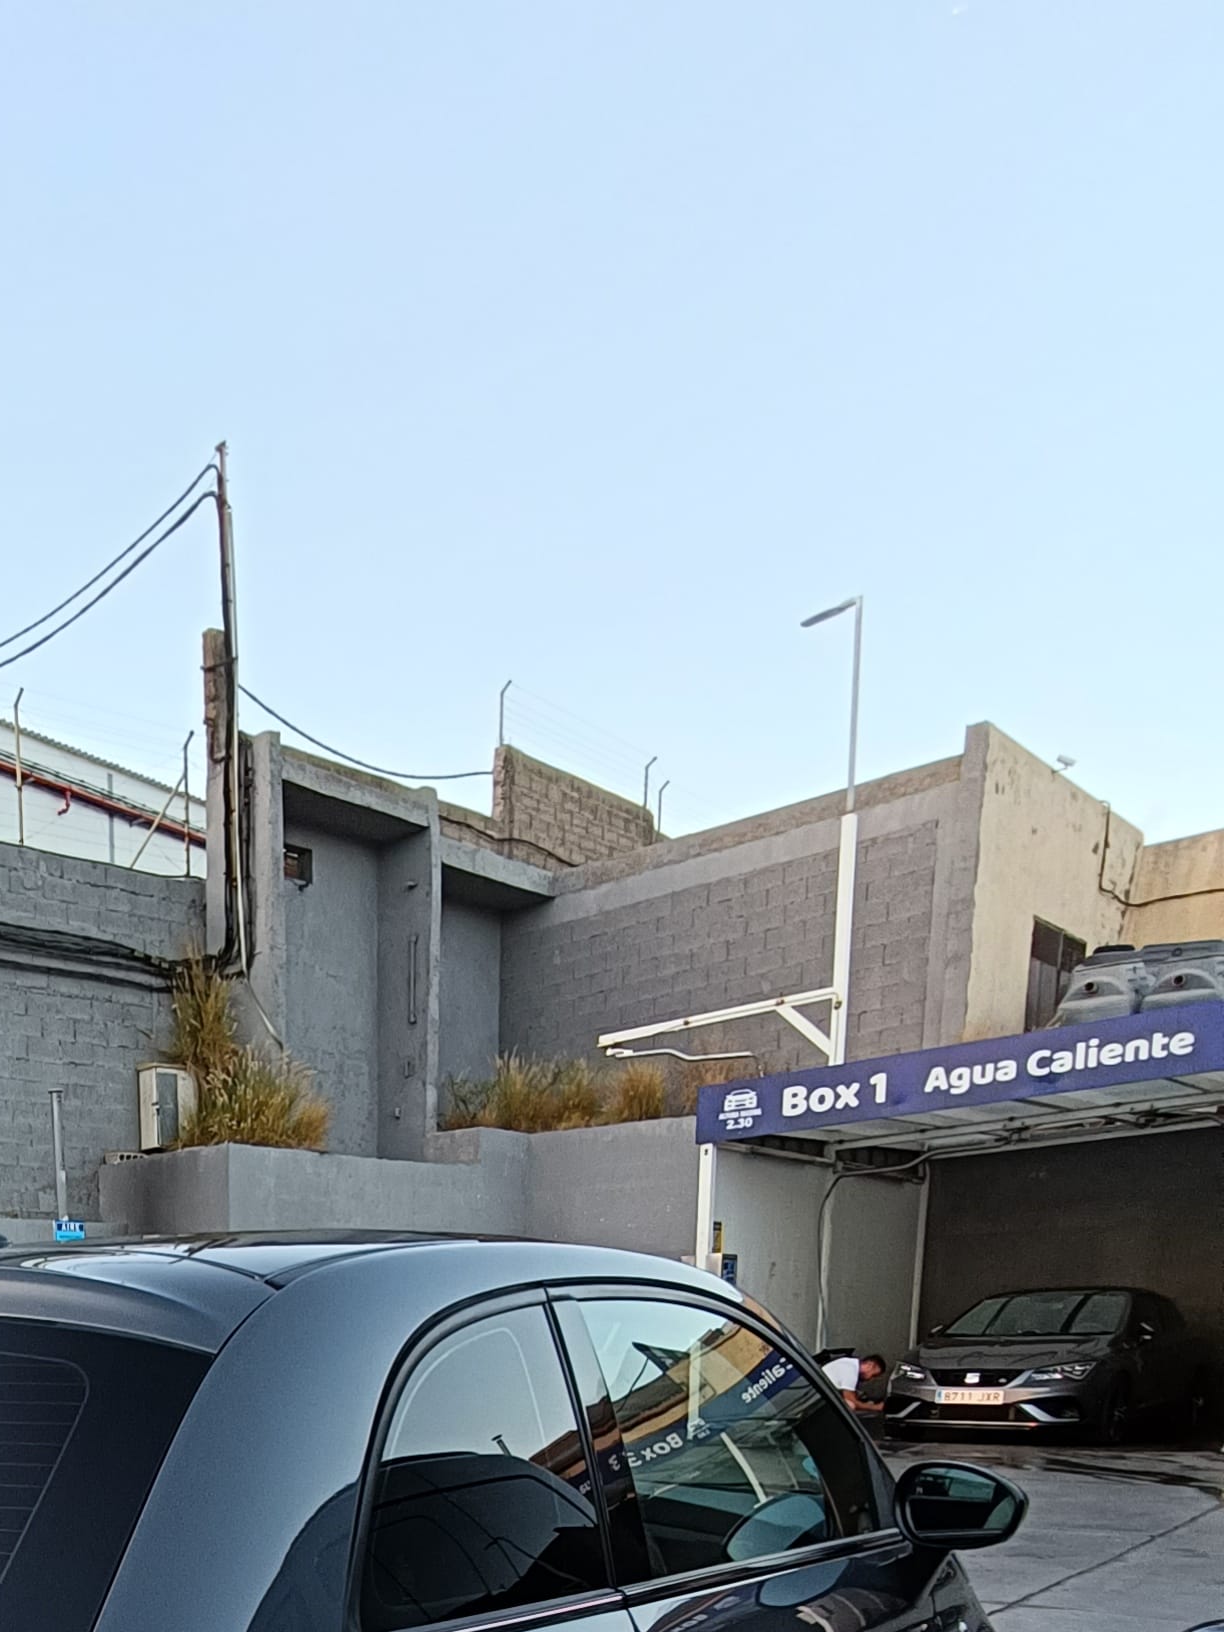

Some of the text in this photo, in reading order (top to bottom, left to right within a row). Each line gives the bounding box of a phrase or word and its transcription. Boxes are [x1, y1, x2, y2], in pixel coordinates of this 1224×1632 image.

[781, 1031, 1195, 1117] Box 1 Agua Caliente
